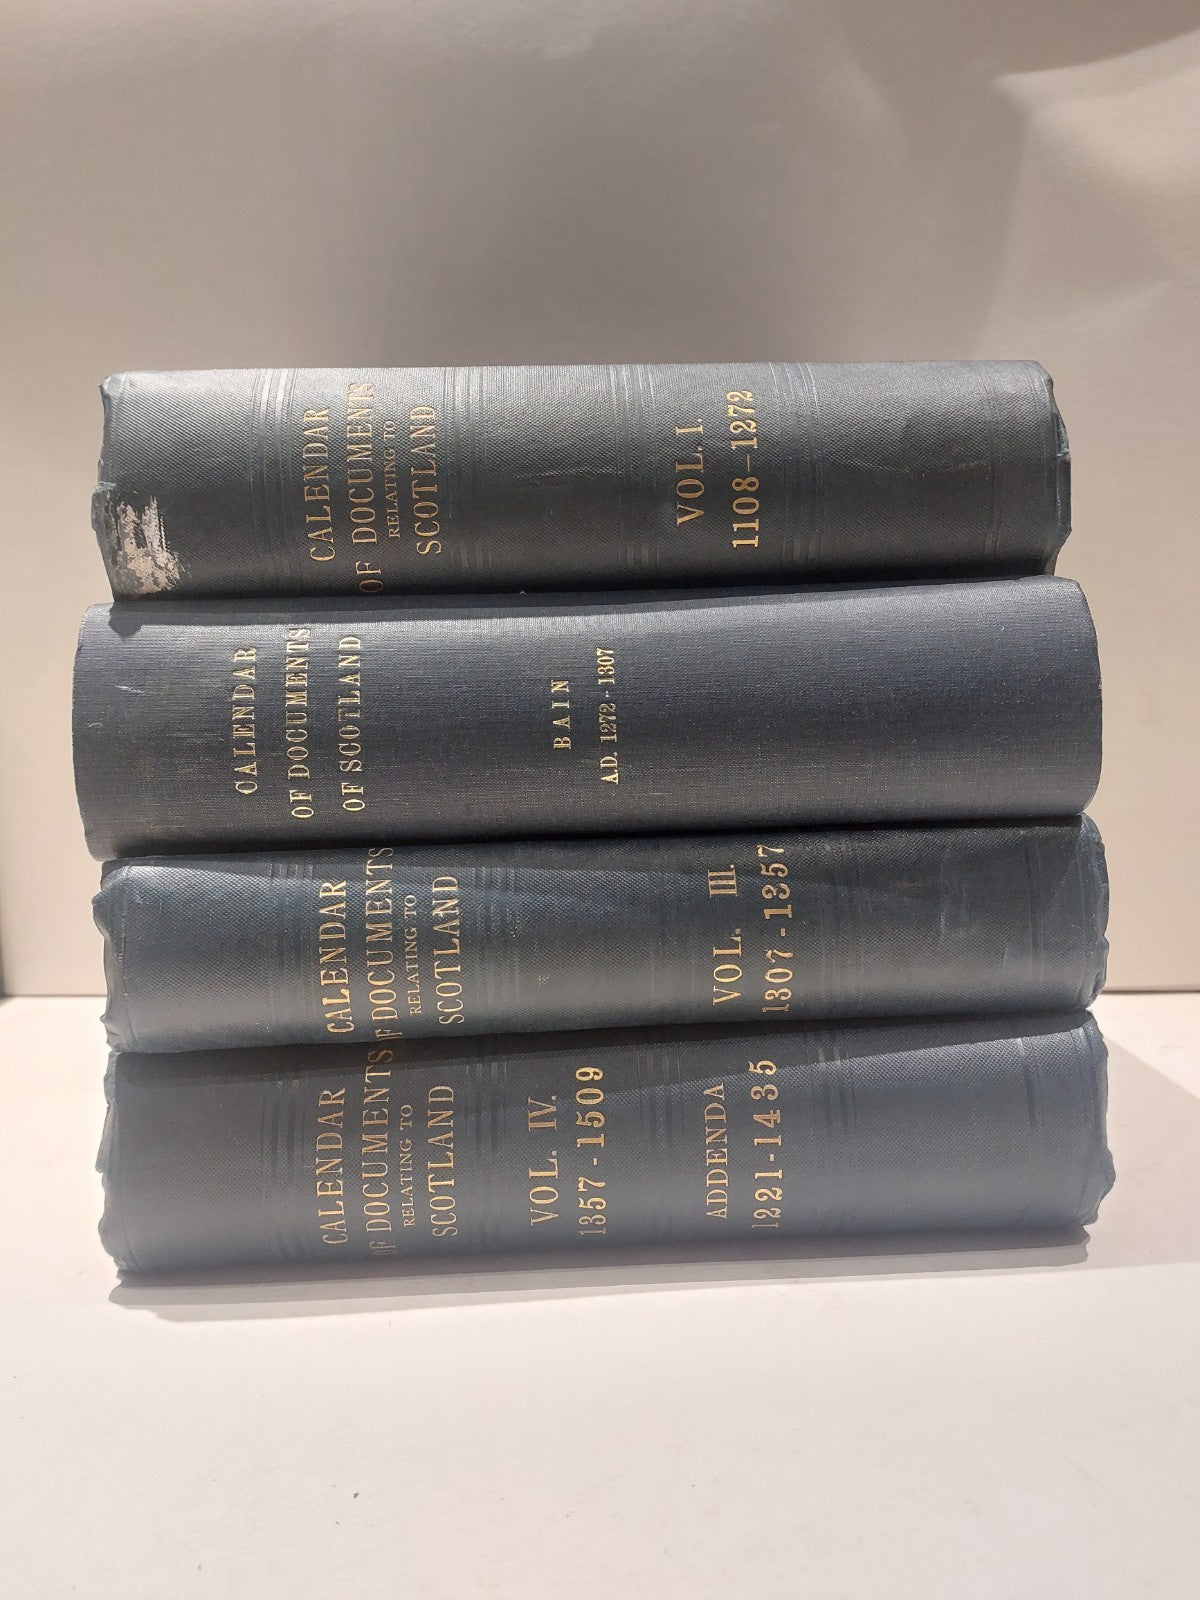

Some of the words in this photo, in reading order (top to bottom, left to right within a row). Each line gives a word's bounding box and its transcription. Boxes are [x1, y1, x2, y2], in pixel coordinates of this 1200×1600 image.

[347, 381, 377, 545] DOCUMENTS
[383, 420, 396, 441] TO
[675, 418, 704, 436] I.
[303, 406, 336, 561] CALENDAR
[384, 449, 400, 538] RELATING
[410, 405, 442, 555] SCOTLAND
[675, 446, 705, 527] VOL.
[355, 560, 384, 593] OF
[232, 646, 258, 795] CALENDAR
[285, 627, 311, 779] DOCUMENTS
[337, 636, 363, 772] SCOTLAND
[550, 680, 572, 750] BAIN
[289, 789, 315, 818] OF
[341, 782, 366, 811] OF
[600, 752, 619, 786] A.D.
[404, 895, 418, 919] TO
[707, 864, 739, 898] III.
[319, 880, 355, 1033] CALENDAR
[365, 847, 398, 1021] DOCUMENTS
[404, 927, 422, 1015] RELATING
[432, 876, 465, 1025] SCOTLAND
[712, 928, 743, 1005] VOL.
[361, 1049, 393, 1233] DOCUMENTS
[399, 1104, 413, 1128] TO
[527, 1095, 558, 1132] IV.
[703, 1081, 729, 1219] ADDENDA
[316, 1087, 349, 1245] CALENDAR
[400, 1138, 416, 1228] RELATING
[427, 1085, 458, 1237] SCOTLAND
[528, 1151, 559, 1226] VOL.
